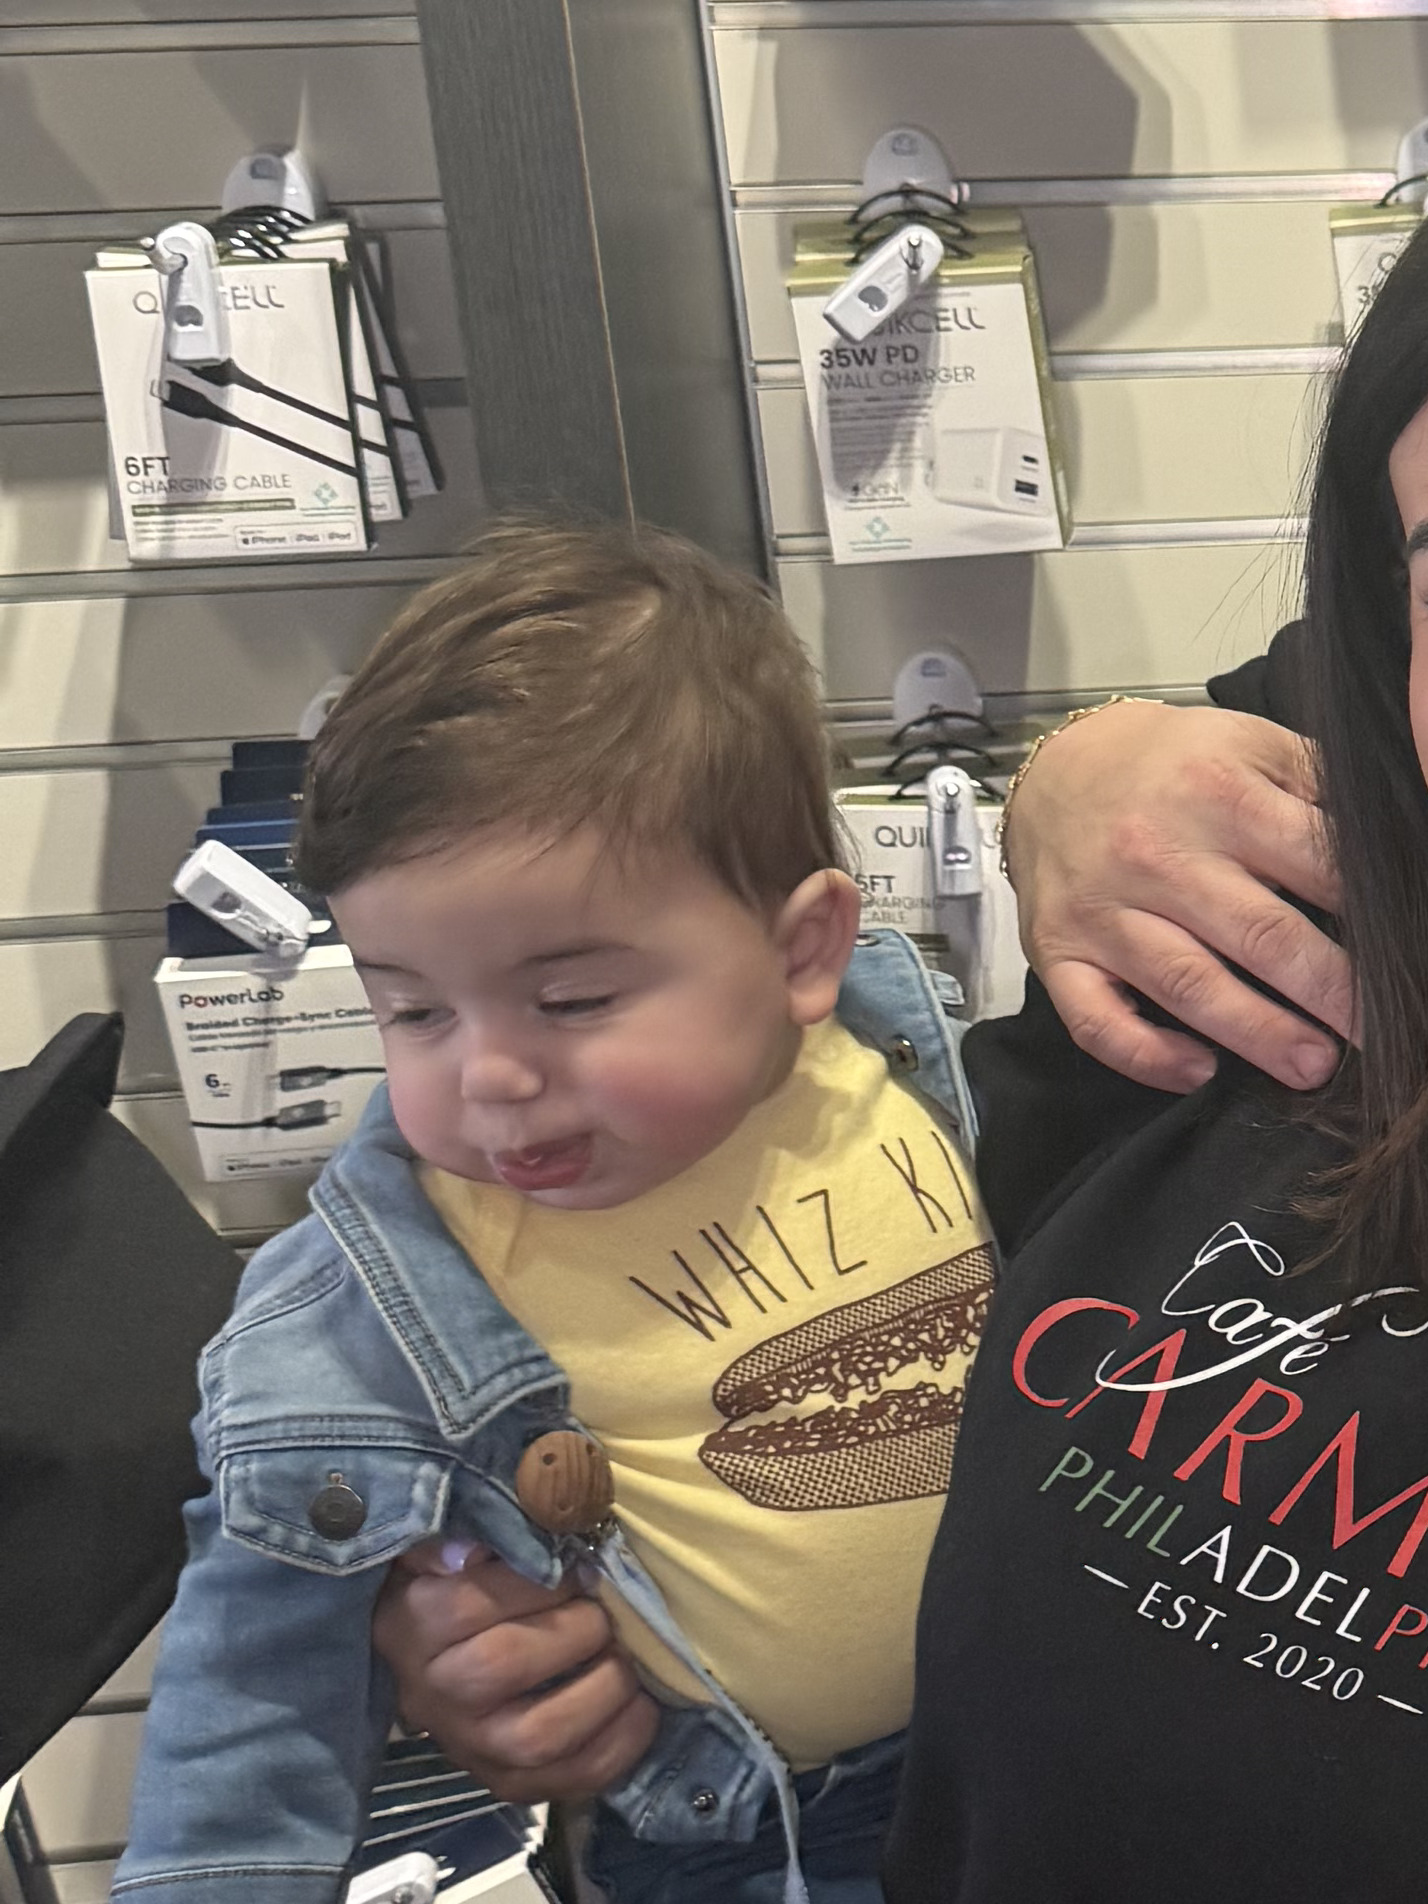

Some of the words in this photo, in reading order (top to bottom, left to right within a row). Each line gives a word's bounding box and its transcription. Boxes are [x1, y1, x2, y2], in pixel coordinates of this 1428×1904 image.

[132, 285, 285, 315] QELL
[820, 347, 878, 369] 35W
[886, 346, 919, 366] PD
[821, 369, 872, 391] WALL
[881, 366, 976, 387] CHARGER
[124, 457, 171, 478] 6FT
[126, 476, 228, 496] CHARGING
[233, 474, 292, 491] CABLE
[250, 534, 286, 546] iPhone
[179, 987, 285, 1010] PowerLab
[628, 1188, 868, 1342] WHIZ
[880, 1130, 973, 1234] KI
[1136, 1581, 1229, 1651] EST.
[1243, 1632, 1365, 1701] 2020
